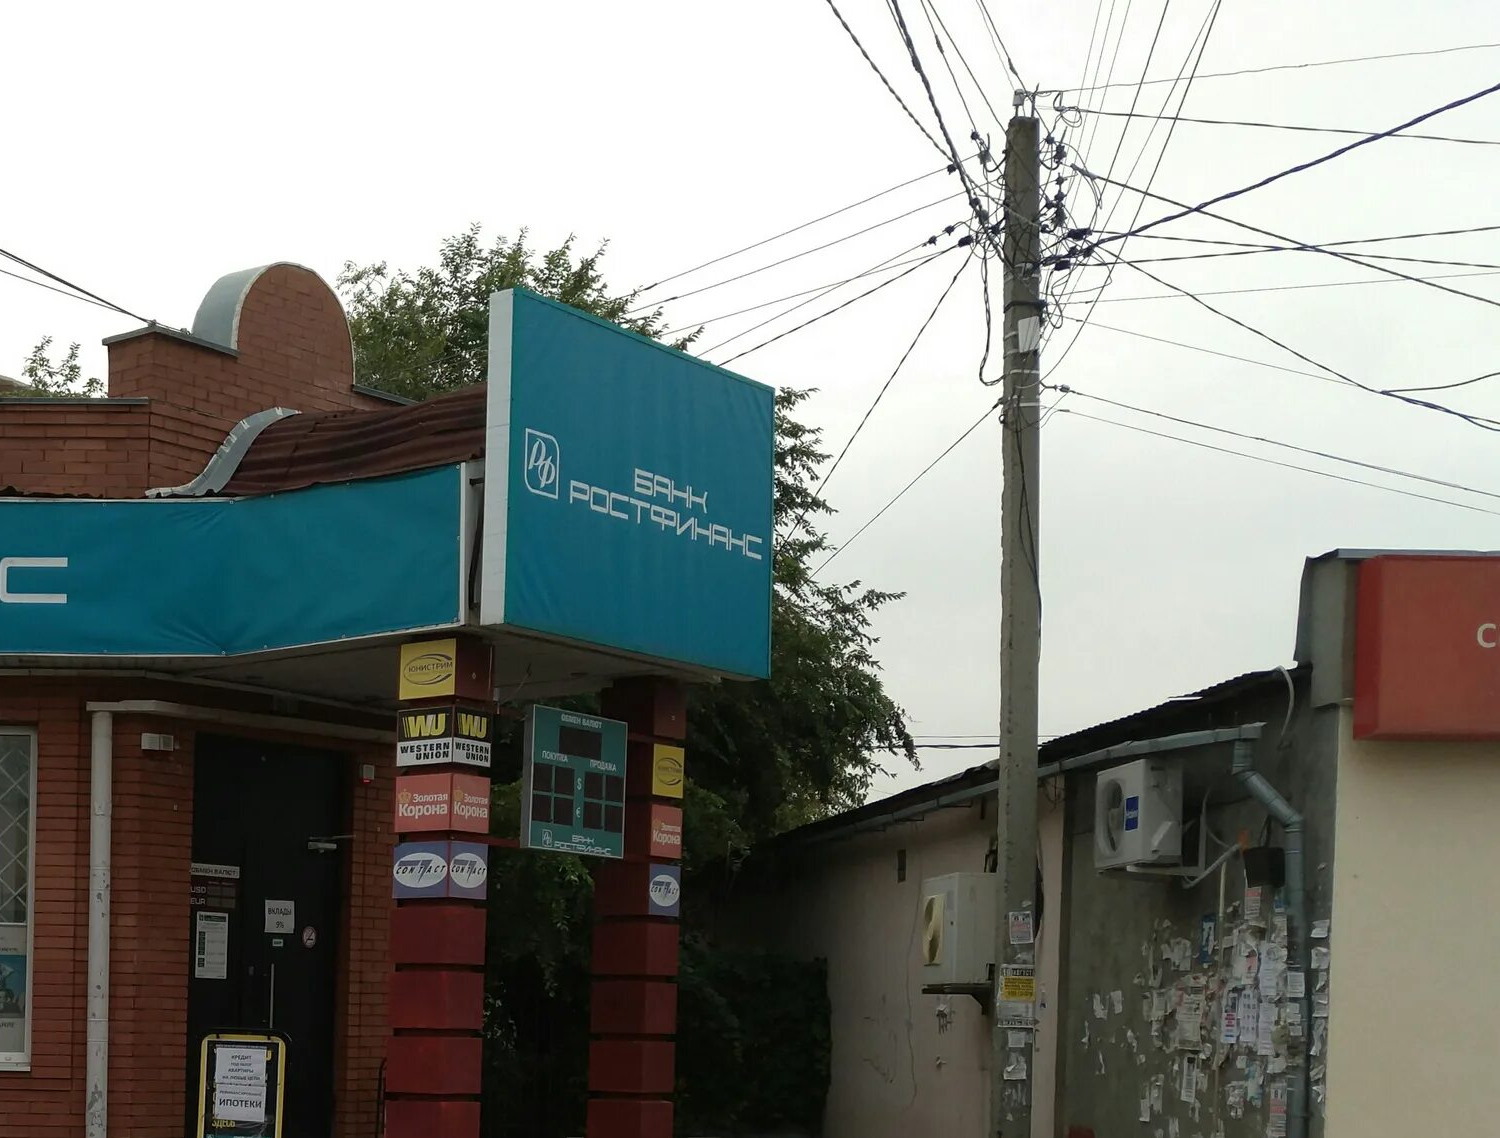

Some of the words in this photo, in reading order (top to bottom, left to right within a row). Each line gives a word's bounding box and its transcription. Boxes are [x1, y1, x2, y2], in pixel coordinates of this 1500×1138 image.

[634, 467, 708, 514] БАНК
[569, 479, 763, 561] РОСТФИНАНС
[408, 661, 453, 673] ЮНИСТРИМ
[403, 713, 446, 738] WU
[457, 712, 488, 739] WU
[561, 713, 581, 725] ОБМЕН
[582, 718, 603, 729] ВАЛЮТ
[400, 741, 450, 754] WESTERN
[455, 741, 489, 755] WESTERN
[415, 750, 450, 761] UNION
[465, 752, 489, 763] UNION
[541, 750, 568, 763] ПОКУПКА
[589, 759, 617, 772] ПРОДАЖА
[412, 793, 448, 803] Золотая
[464, 793, 488, 805] Золотая
[398, 803, 448, 819] Корона
[453, 801, 488, 819] Корона
[571, 834, 595, 844] БАНК
[652, 830, 681, 845] Корона
[396, 865, 446, 874] CONTACT
[451, 865, 486, 876] CONTACT
[190, 886, 207, 894] USD
[267, 907, 292, 917] ВКЛАДЫ
[275, 921, 285, 930] 9%
[219, 1098, 262, 1109] ИПОТЕКИ
